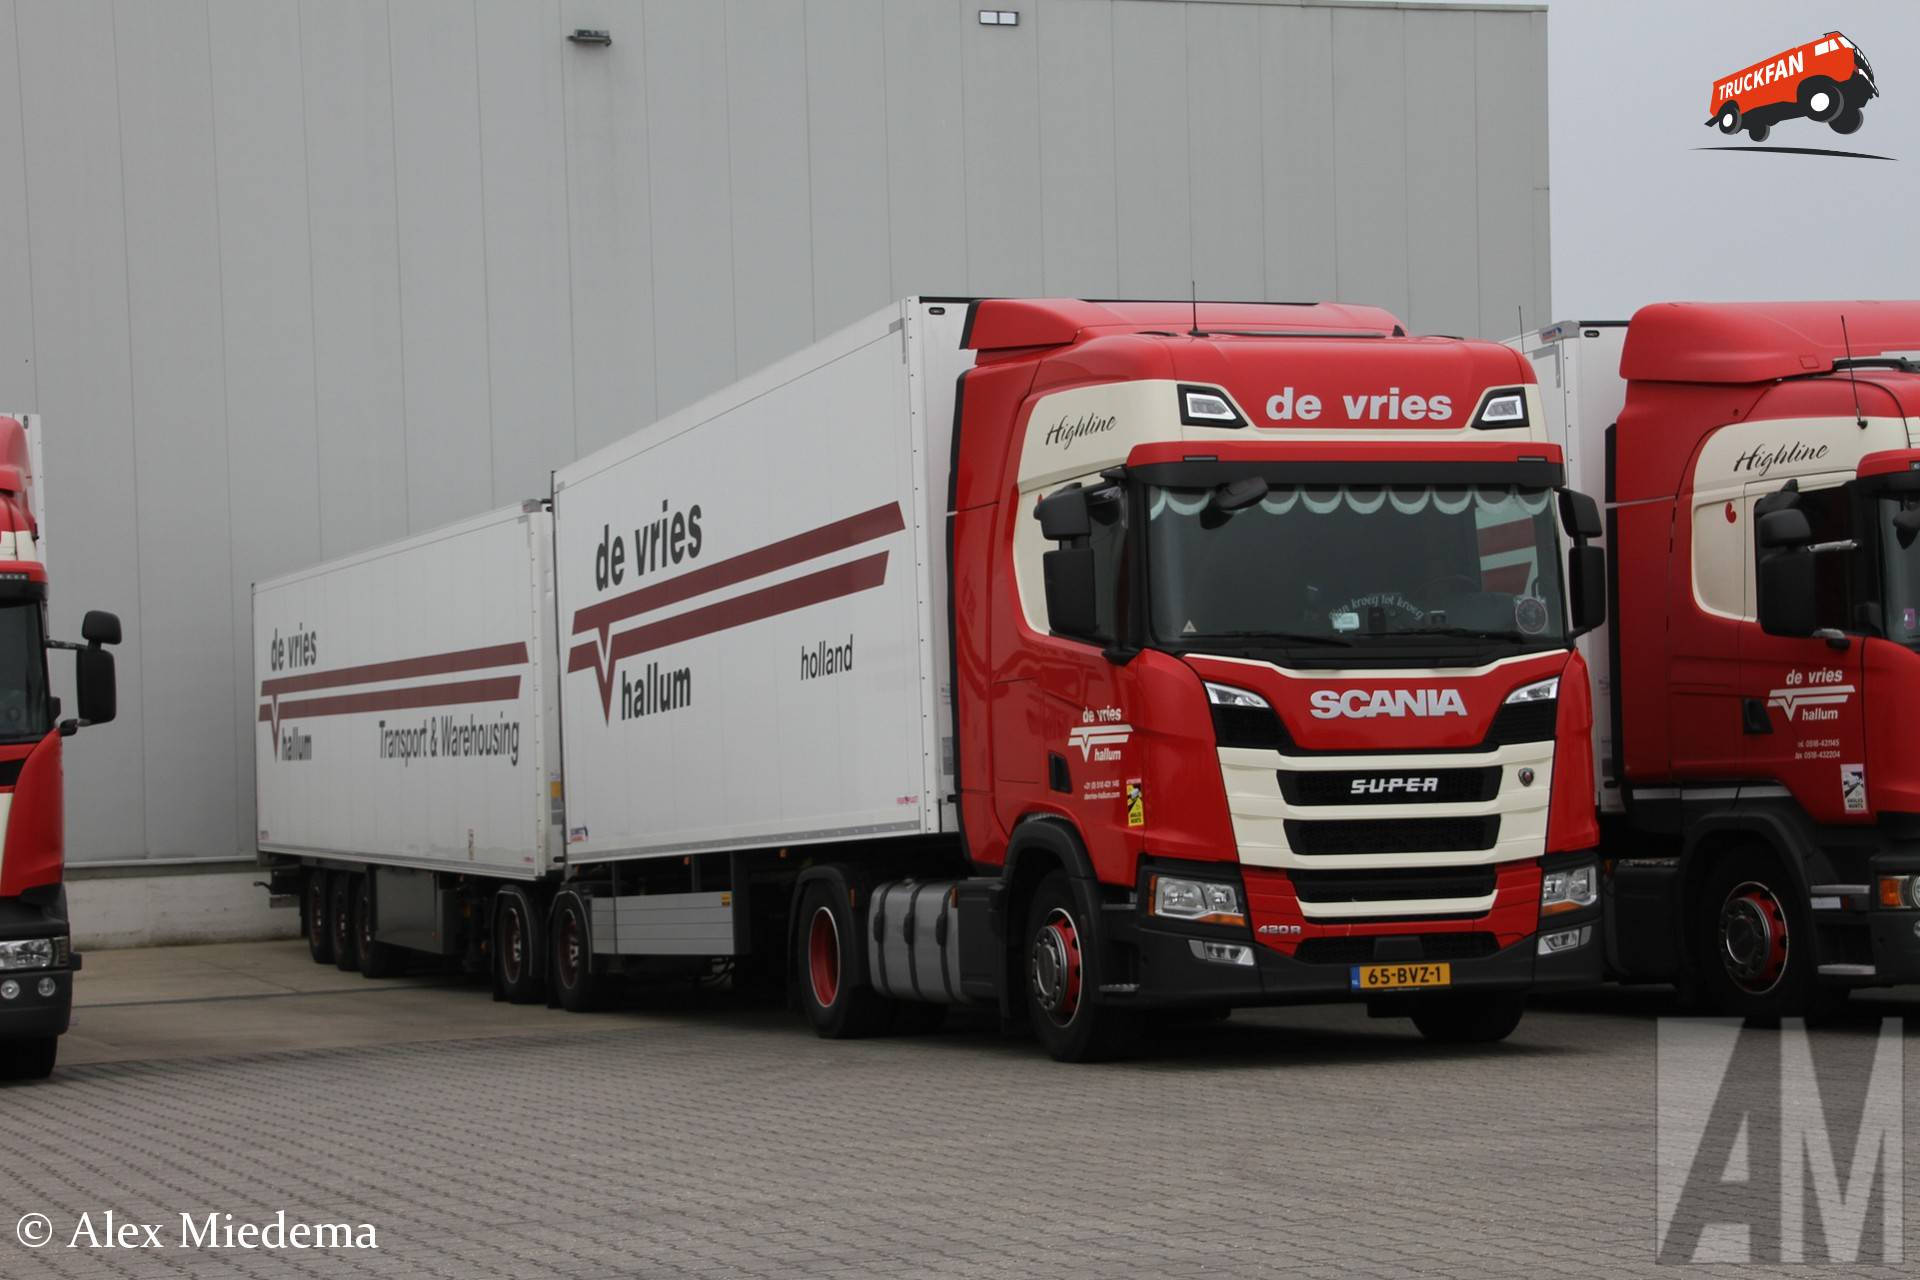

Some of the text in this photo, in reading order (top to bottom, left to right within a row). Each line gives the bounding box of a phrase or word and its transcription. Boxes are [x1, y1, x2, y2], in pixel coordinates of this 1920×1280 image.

[1266, 387, 1452, 421] de vries
[1045, 412, 1116, 450] Highline
[1733, 441, 1829, 477] Highline
[596, 499, 702, 592] de vries
[271, 622, 317, 671] de vries
[801, 634, 853, 681] holland
[621, 662, 691, 720] hallum
[1786, 667, 1843, 685] de vries
[1083, 705, 1121, 723] de vries
[1310, 689, 1468, 719] SCANIA
[1802, 708, 1838, 721] hallum
[282, 727, 312, 760] hallum
[379, 711, 520, 767] Transport & Warehousing
[1095, 748, 1121, 761] hallum
[1351, 777, 1438, 794] SUPER
[1368, 966, 1441, 984] 65-BVZ-1
